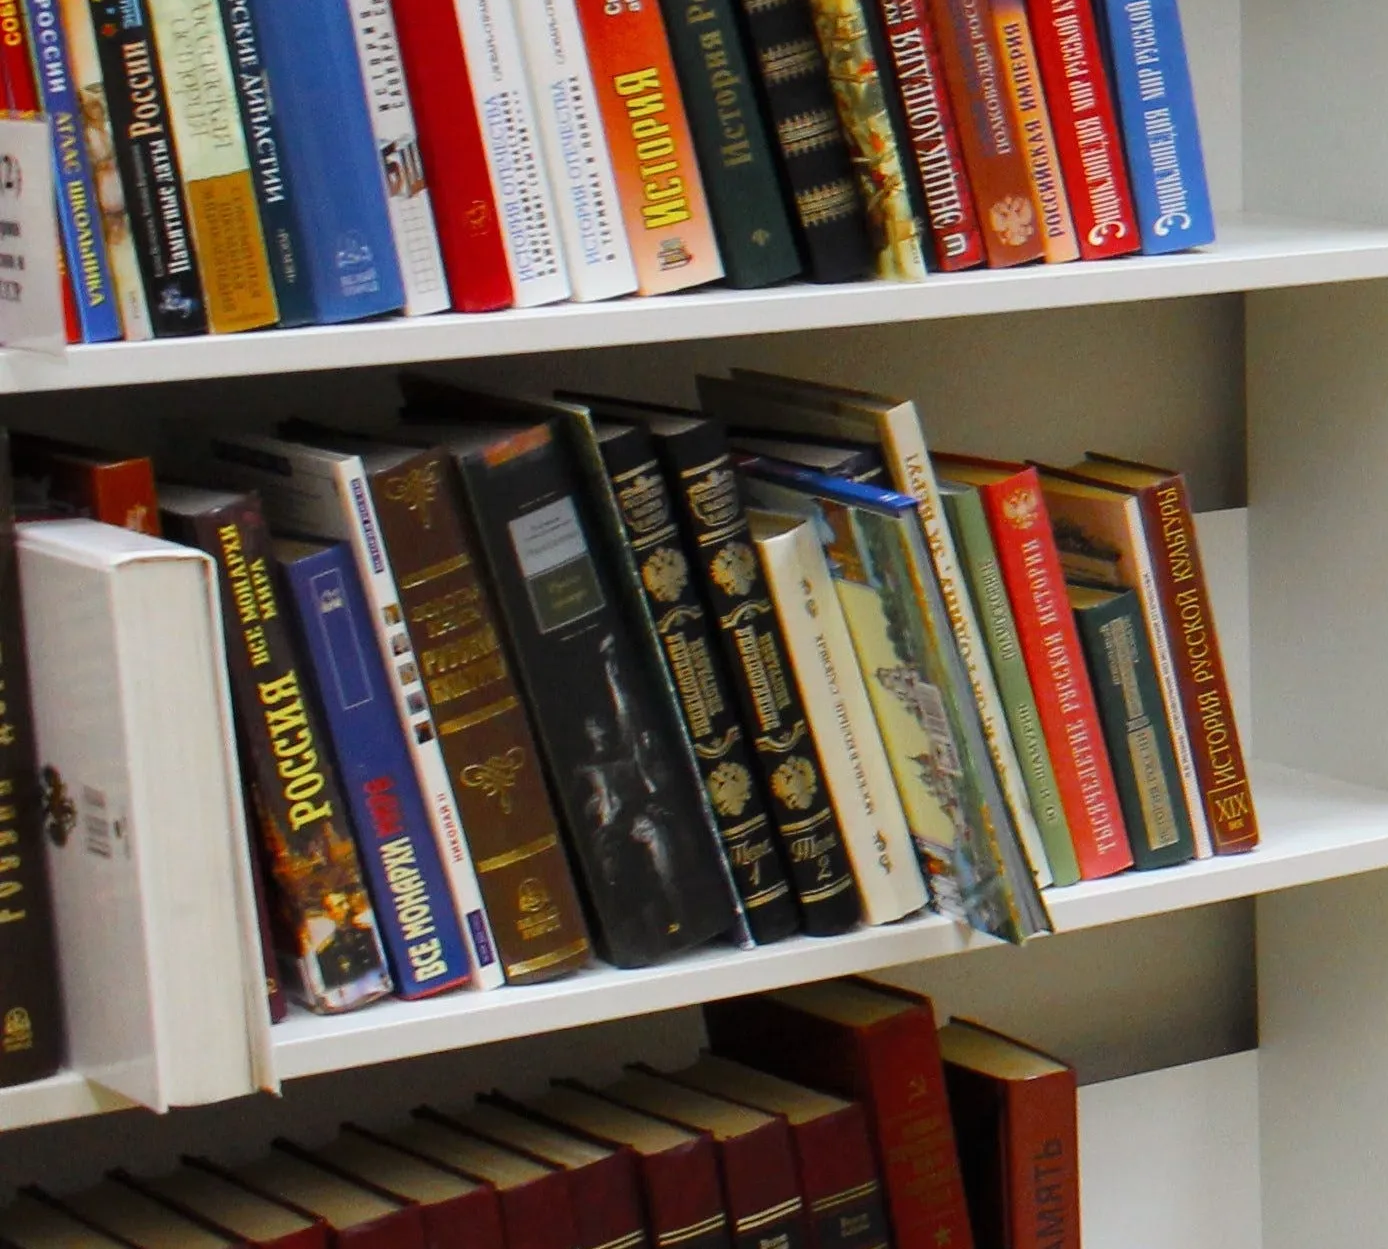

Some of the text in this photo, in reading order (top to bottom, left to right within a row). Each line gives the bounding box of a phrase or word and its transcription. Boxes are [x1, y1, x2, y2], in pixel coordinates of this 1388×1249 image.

[1054, 12, 1090, 77] РУССКОЙ
[1067, 78, 1096, 111] МИР
[243, 69, 284, 203] ДИНАСТИИ
[612, 66, 692, 231] ИСТОРИЯ
[1001, 22, 1064, 238] РОССИЙСКАЯ ИМПЕРИЯ
[1156, 487, 1240, 786] ИСТОРИЯ РУССКОЙ КУЛЬТУРЫ
[256, 669, 331, 833] РОССИЯ
[382, 836, 448, 981] ВСЕ МОНАРХИ
